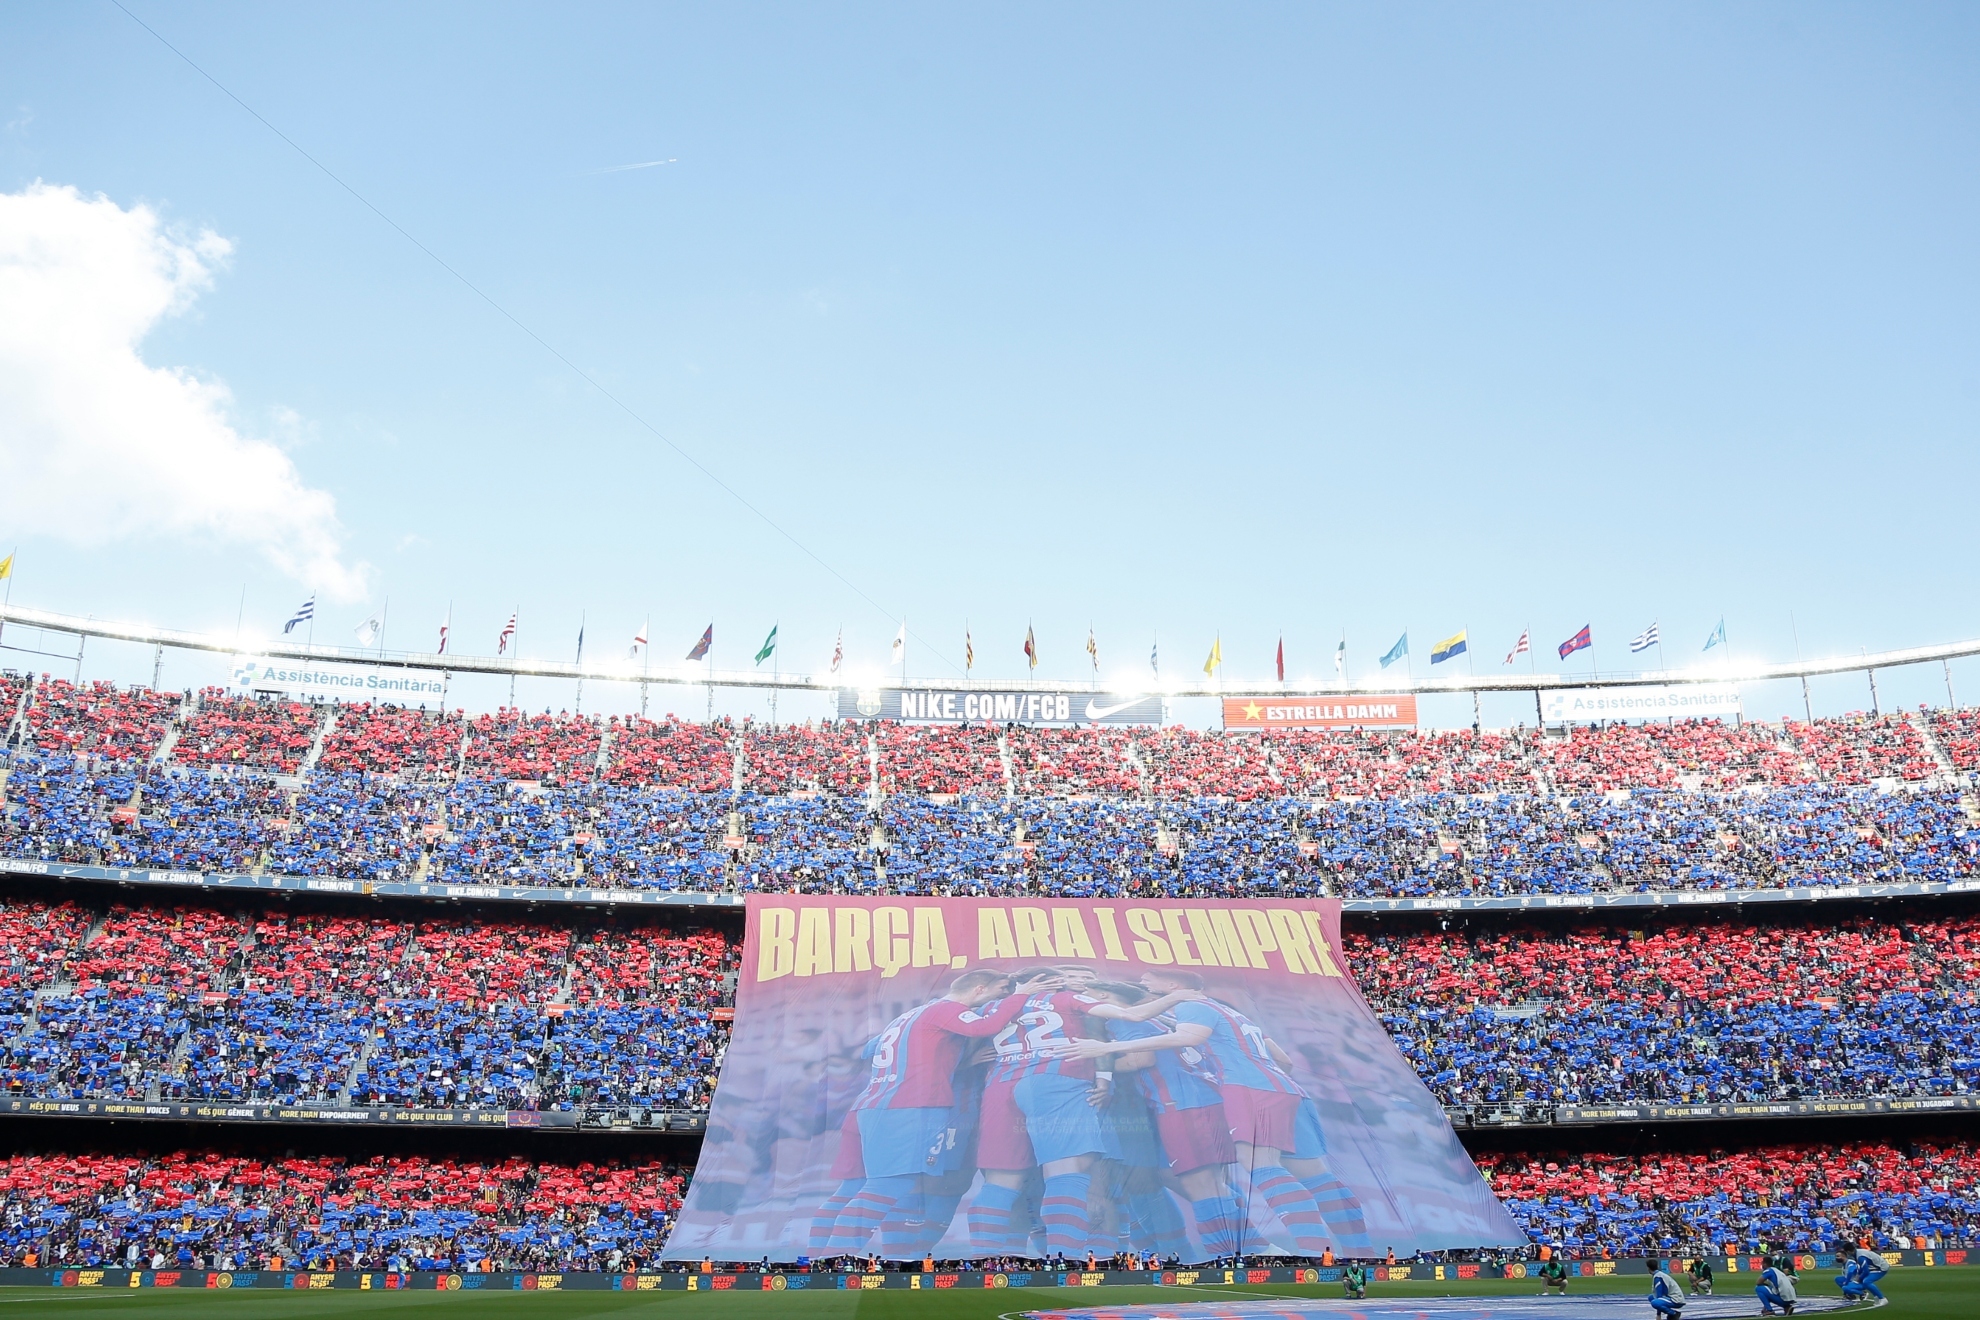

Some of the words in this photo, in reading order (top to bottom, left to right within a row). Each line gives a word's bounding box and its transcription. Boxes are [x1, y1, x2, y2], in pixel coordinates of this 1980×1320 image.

[263, 667, 364, 688] Assistència
[366, 674, 442, 693] Sanitària
[900, 692, 1070, 720] NIKE.COM/FCB
[1267, 705, 1343, 720] ESTRELLA
[1346, 704, 1397, 719] DAMM
[447, 886, 500, 898] NIKE.COM/FCB
[591, 891, 642, 902] NIKE.COM/FCB
[1810, 887, 1860, 898] NIKE.COM/FCB
[1546, 896, 1594, 906] NIKE.COM/FCB
[1678, 893, 1727, 903] NIKE.COM/FCB
[1413, 899, 1461, 909] NIKE.COM/FCB
[757, 906, 968, 982] BARÇA,
[977, 907, 1097, 960] ARA
[999, 1051, 1035, 1063] unicef
[45, 1103, 60, 1112] QUE
[61, 1103, 80, 1112] VEUS
[1826, 1104, 1840, 1112] QUE
[1840, 1103, 1850, 1111] UN
[1922, 1100, 1955, 1108] JUGADORS
[105, 1104, 125, 1113] MORE
[126, 1105, 145, 1114] THAN
[146, 1106, 170, 1115] VOICES
[212, 1108, 227, 1117] QUE
[279, 1110, 299, 1118] MORE
[300, 1110, 319, 1119] THAN
[319, 1110, 369, 1119] EMPOWERMENT
[1581, 1110, 1599, 1118] MORE
[1616, 1109, 1638, 1117] PROUD
[1690, 1107, 1712, 1115] TALENT
[1734, 1106, 1751, 1114] MORE
[1769, 1105, 1790, 1113] TALENT
[410, 1112, 424, 1121] QUE
[425, 1113, 436, 1121] UN
[436, 1113, 453, 1121] CLUB
